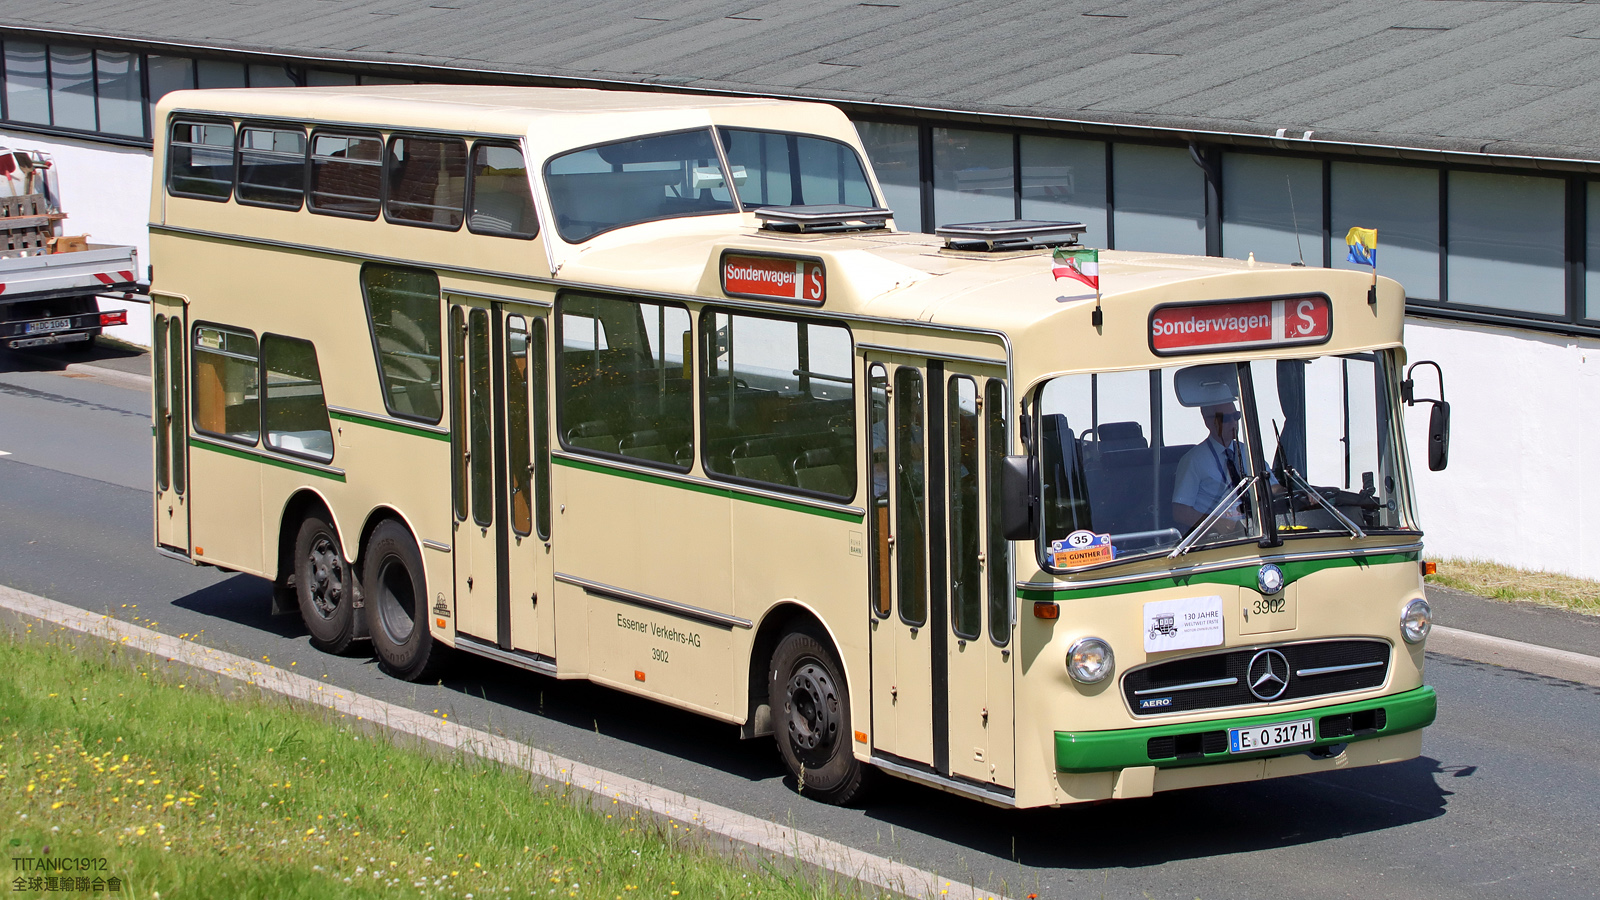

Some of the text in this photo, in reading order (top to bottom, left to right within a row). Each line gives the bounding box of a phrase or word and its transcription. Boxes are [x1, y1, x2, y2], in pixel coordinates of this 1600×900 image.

[727, 264, 822, 299] Sonderwagen S
[1152, 301, 1314, 337] Sonderwagen S
[1074, 535, 1088, 545] 35
[1069, 551, 1101, 560] GÜNTHER
[1253, 598, 1286, 615] 3902
[1184, 610, 1219, 621] 130 JAHRE
[617, 613, 701, 648] Essener Verkehrs-AG
[651, 647, 669, 663] 3902
[1142, 698, 1170, 708] AERO
[1241, 731, 1251, 748] E
[1274, 725, 1298, 744] 317
[1302, 722, 1311, 740] H
